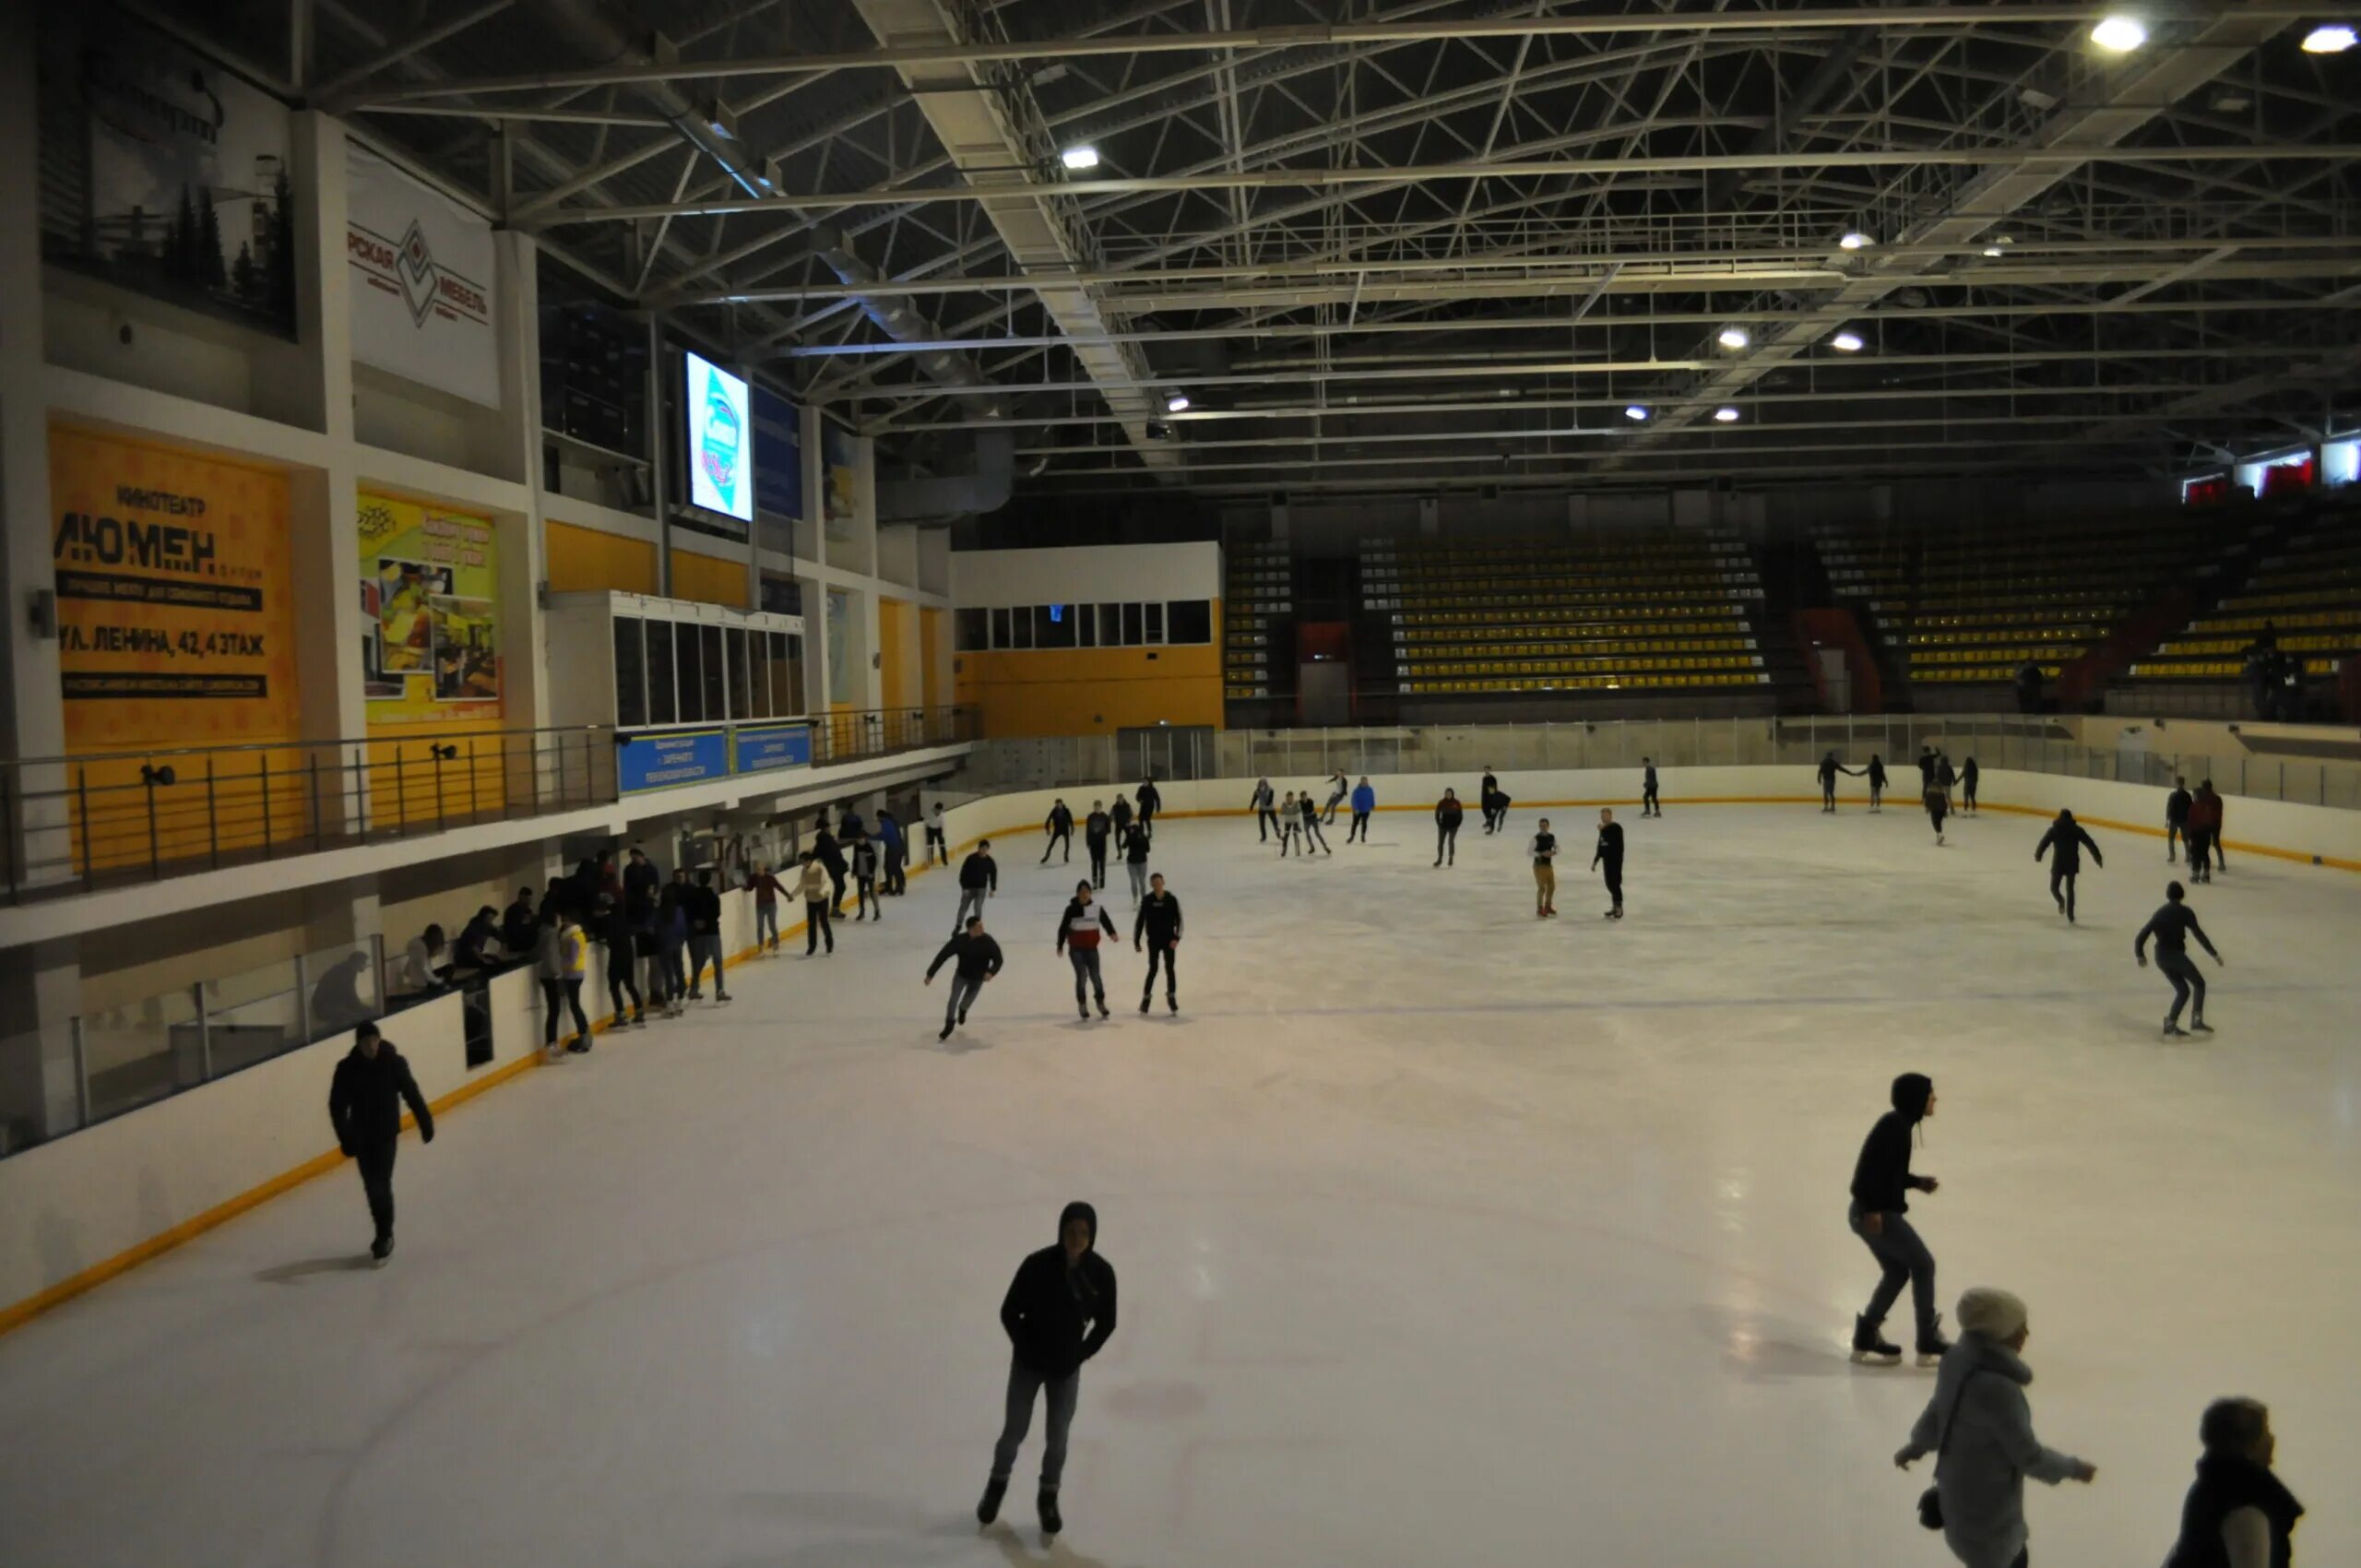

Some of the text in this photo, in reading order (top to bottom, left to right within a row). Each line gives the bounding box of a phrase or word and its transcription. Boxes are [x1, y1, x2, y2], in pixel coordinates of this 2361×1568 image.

[440, 276, 488, 315] МЕБЕЛЬ
[116, 485, 207, 517] КИНОТЕАТР
[53, 511, 216, 576] ЛЮМЕН
[58, 624, 90, 651] УЛ.
[94, 625, 176, 658] ЛЕНИНА,
[219, 633, 267, 658] ЭТАЖ
